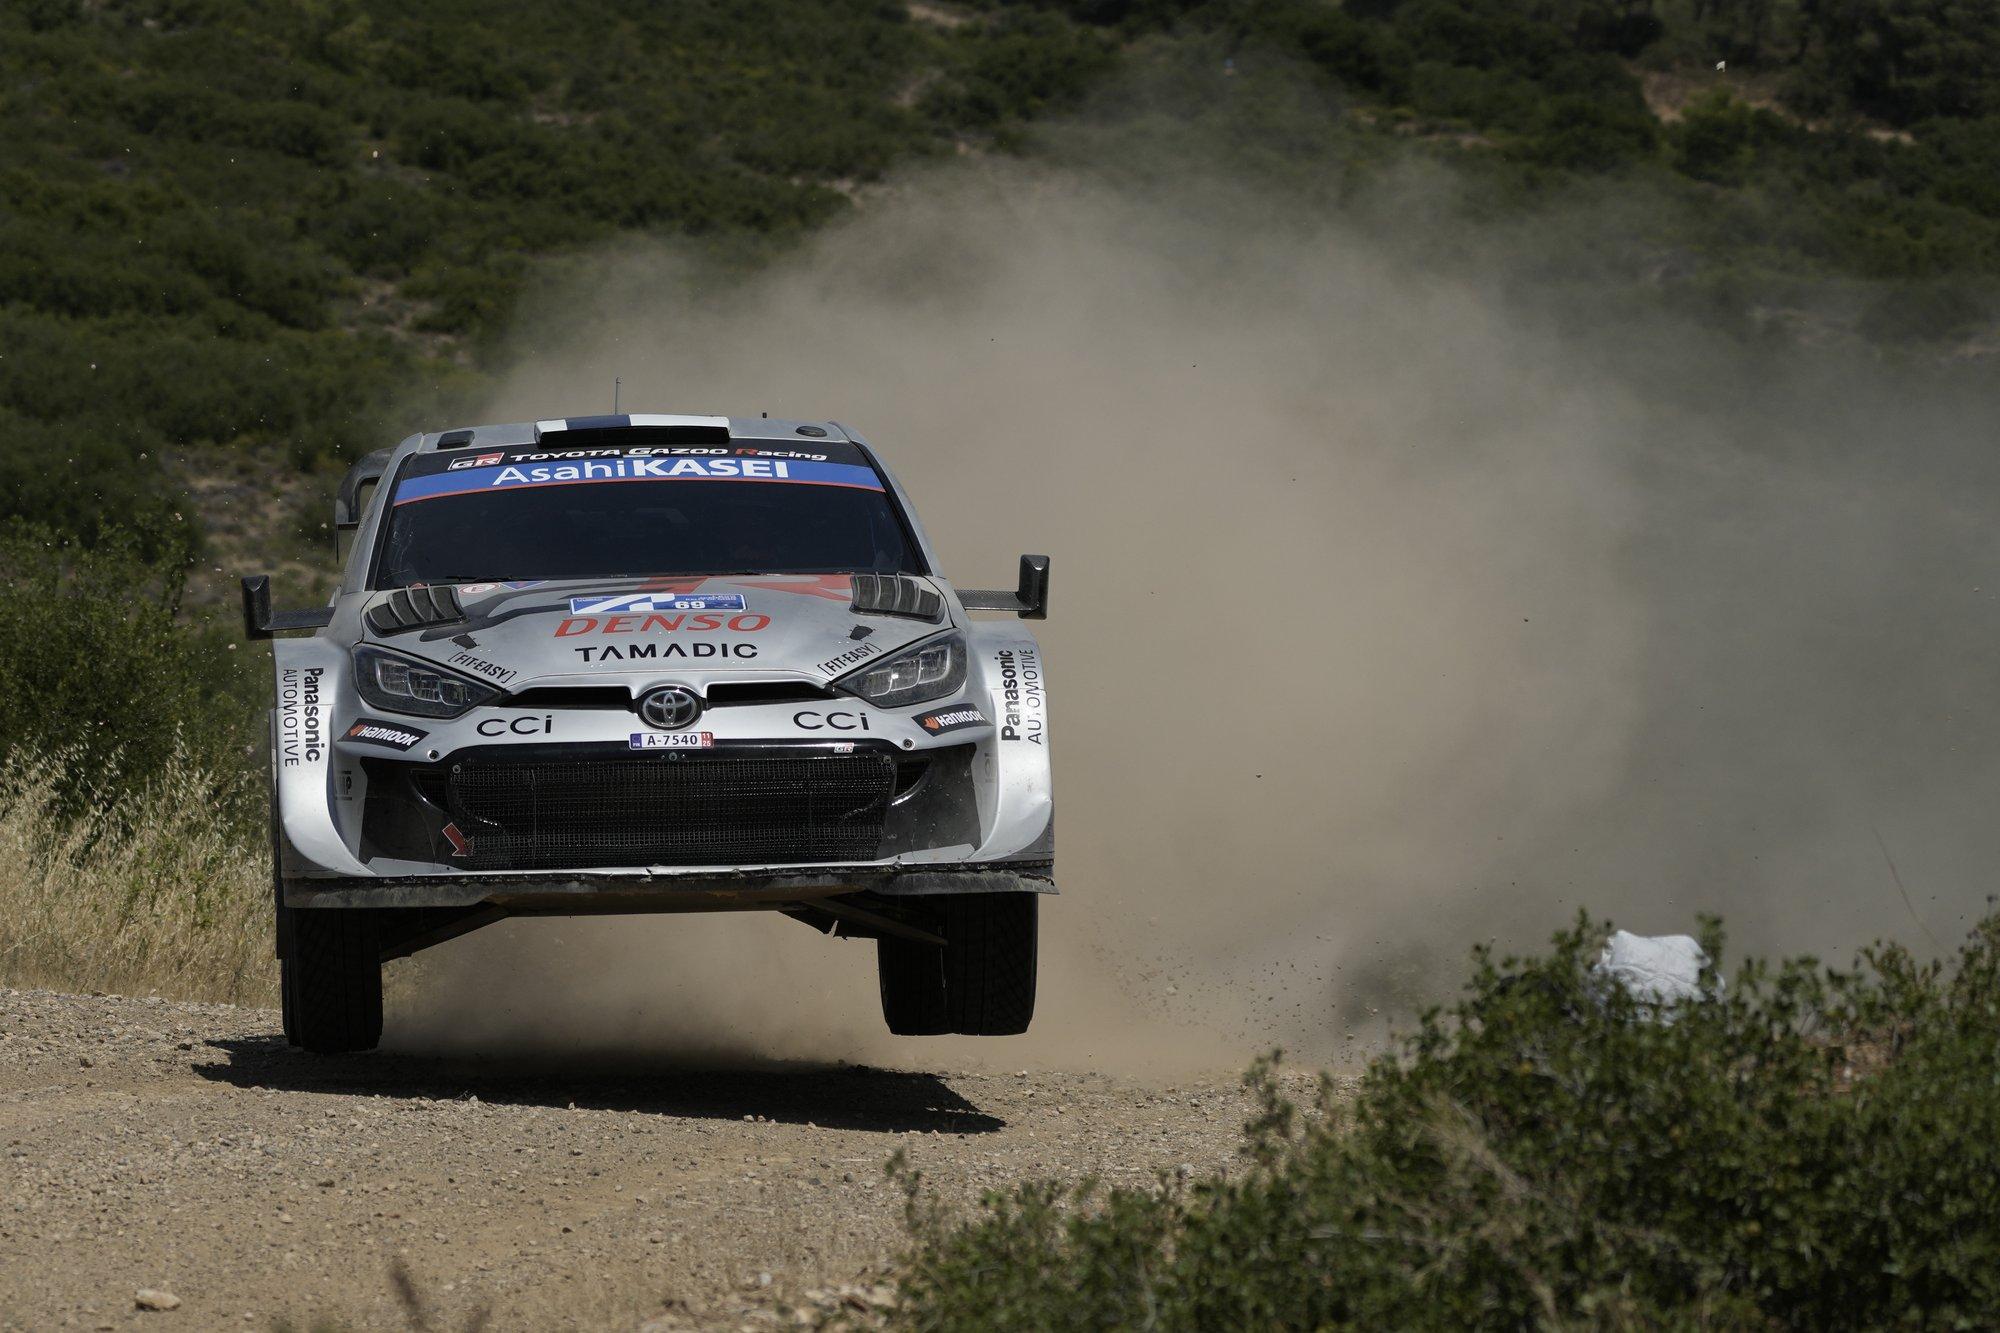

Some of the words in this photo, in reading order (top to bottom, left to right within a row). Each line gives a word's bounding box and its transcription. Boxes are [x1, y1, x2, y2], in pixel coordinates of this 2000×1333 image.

[450, 456, 501, 469] GR
[510, 449, 621, 461] TOYOTA
[628, 447, 729, 455] GAZOO
[735, 448, 828, 460] Racing
[674, 601, 706, 609] 69
[554, 614, 771, 638] DENSO
[574, 643, 759, 662] TAMADIC
[994, 649, 1020, 741] Panasonic
[283, 669, 299, 767] AUTOMOTIVE
[304, 668, 325, 762] Panasonic
[647, 735, 698, 746] A-7540
